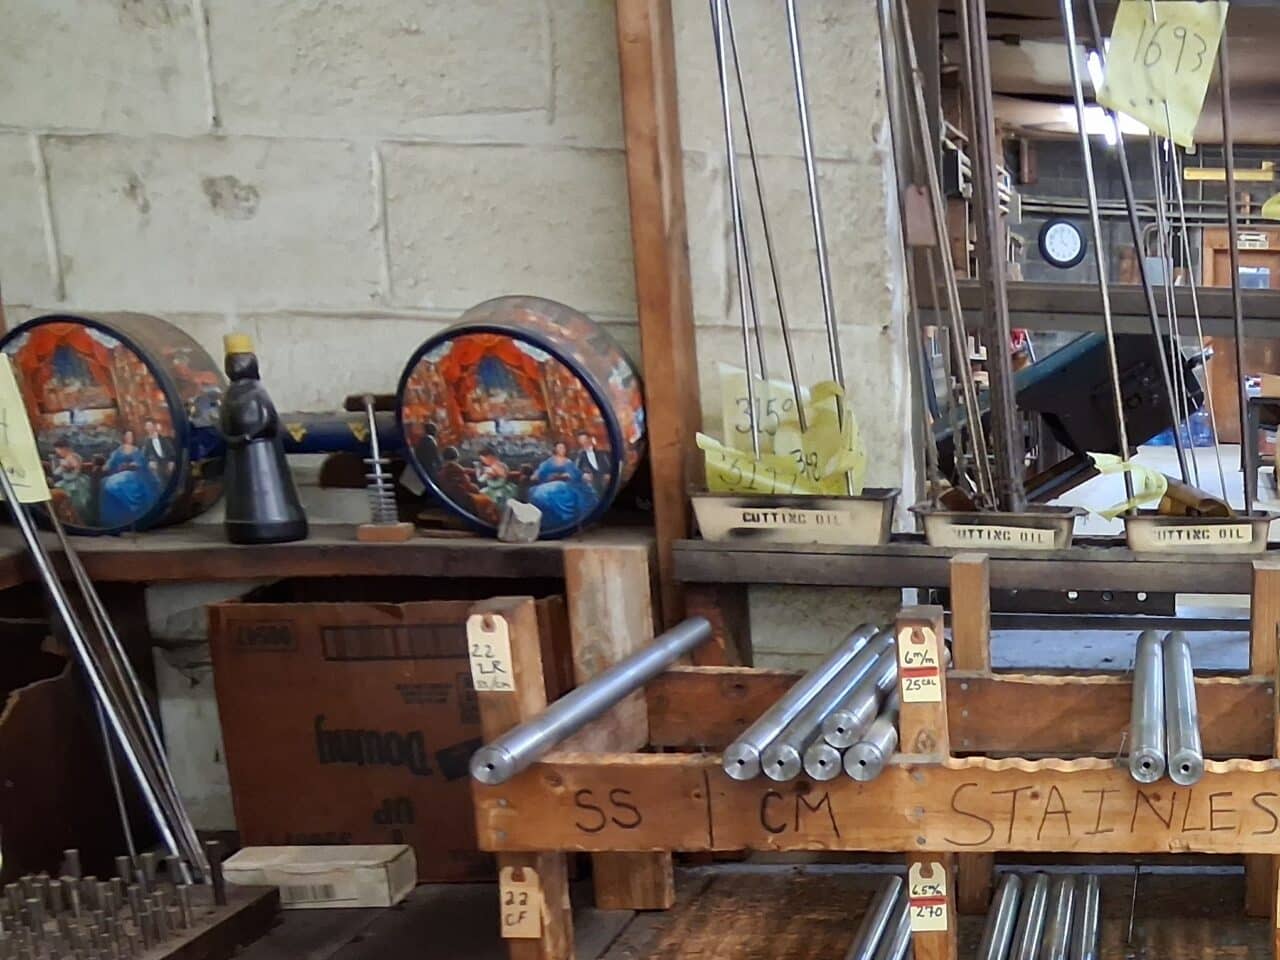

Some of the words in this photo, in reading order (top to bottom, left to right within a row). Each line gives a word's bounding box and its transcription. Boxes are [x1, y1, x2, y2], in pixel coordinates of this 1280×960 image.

[742, 512, 807, 524] CUTTING
[1019, 532, 1045, 544] OIL
[1218, 528, 1245, 541] OIL
[472, 643, 496, 658] 22
[573, 788, 643, 834] SS
[758, 784, 841, 839] CM
[505, 890, 529, 907] 22
[916, 906, 944, 918] 270
